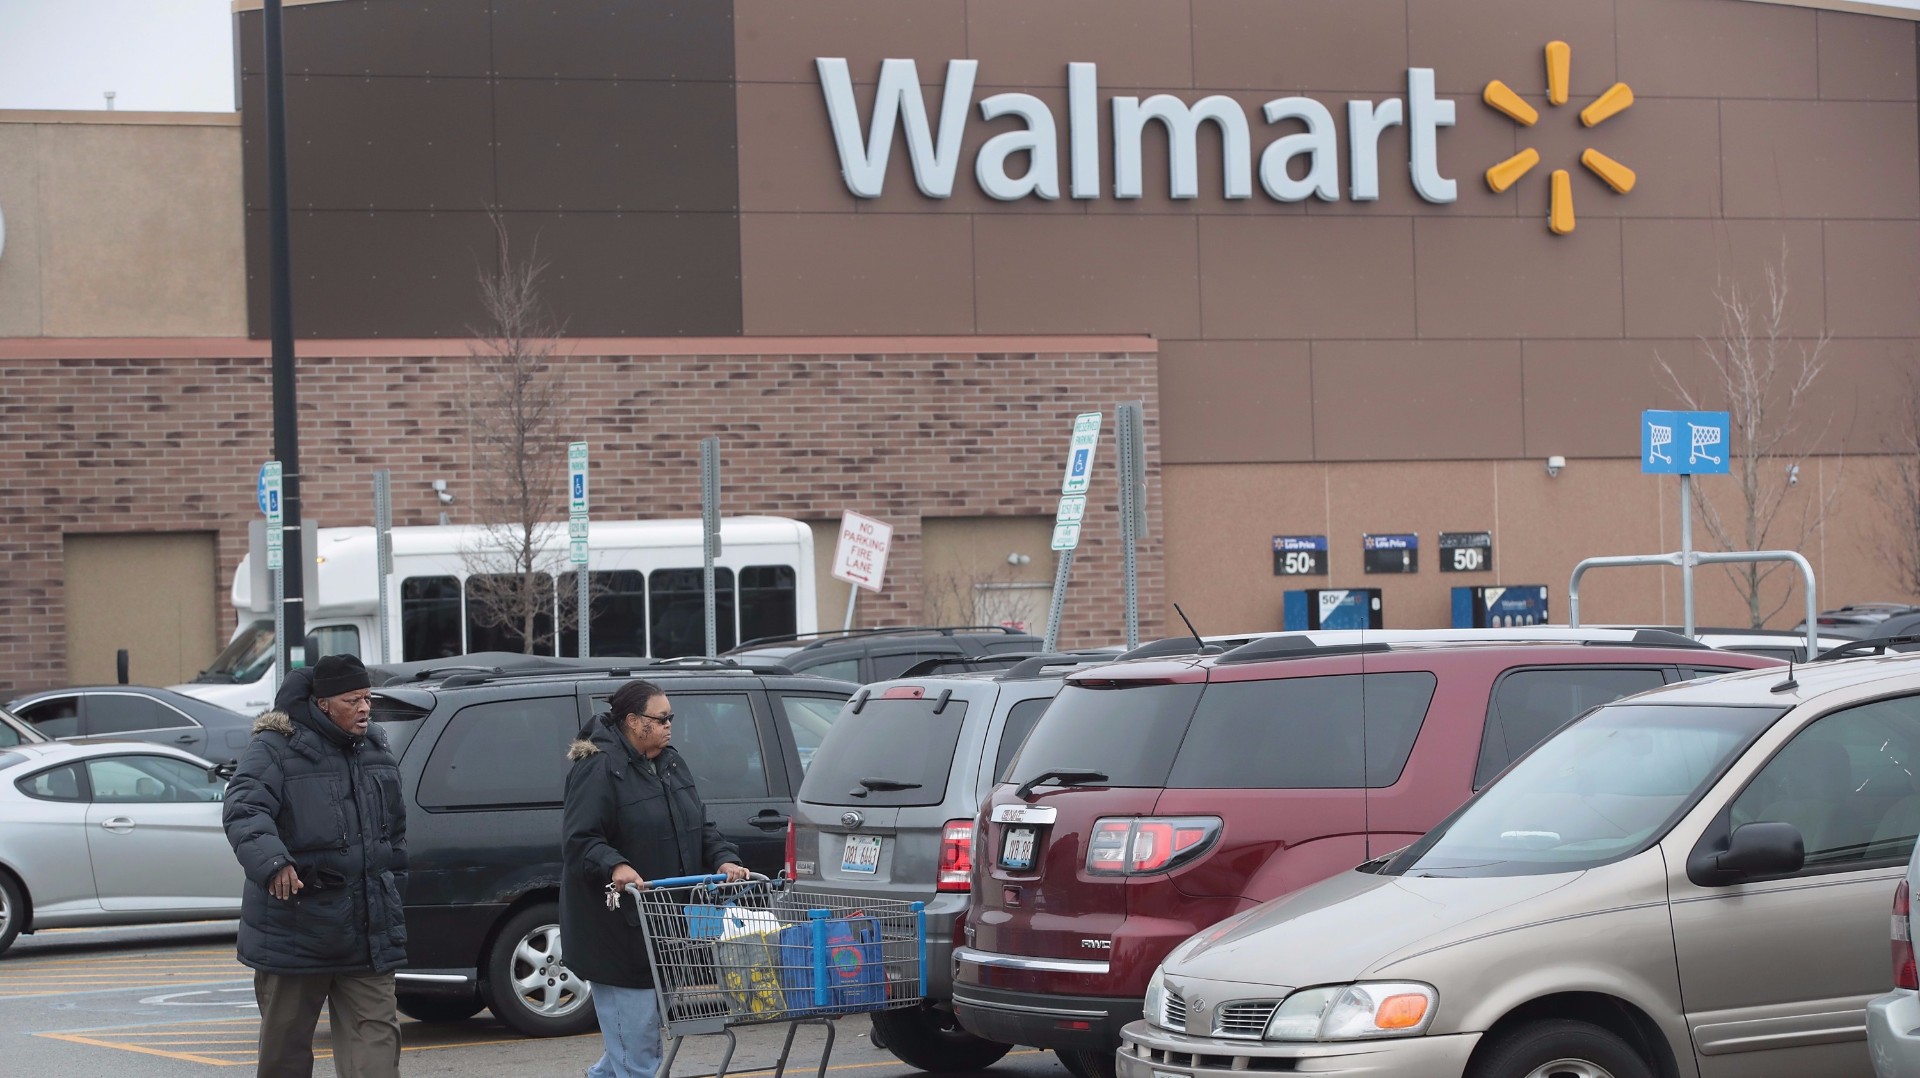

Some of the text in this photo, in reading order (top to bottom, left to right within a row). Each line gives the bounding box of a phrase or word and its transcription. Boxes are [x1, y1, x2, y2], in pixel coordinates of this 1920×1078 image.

[815, 56, 1458, 203] Walmart
[1075, 421, 1099, 432] RESERVED
[1075, 434, 1095, 445] PARKING
[860, 522, 874, 535] NO
[843, 529, 885, 552] PARKING
[851, 545, 873, 561] FIRE
[846, 556, 873, 574] LANE
[1001, 809, 1026, 821] GMC
[1081, 939, 1111, 949] AWD
